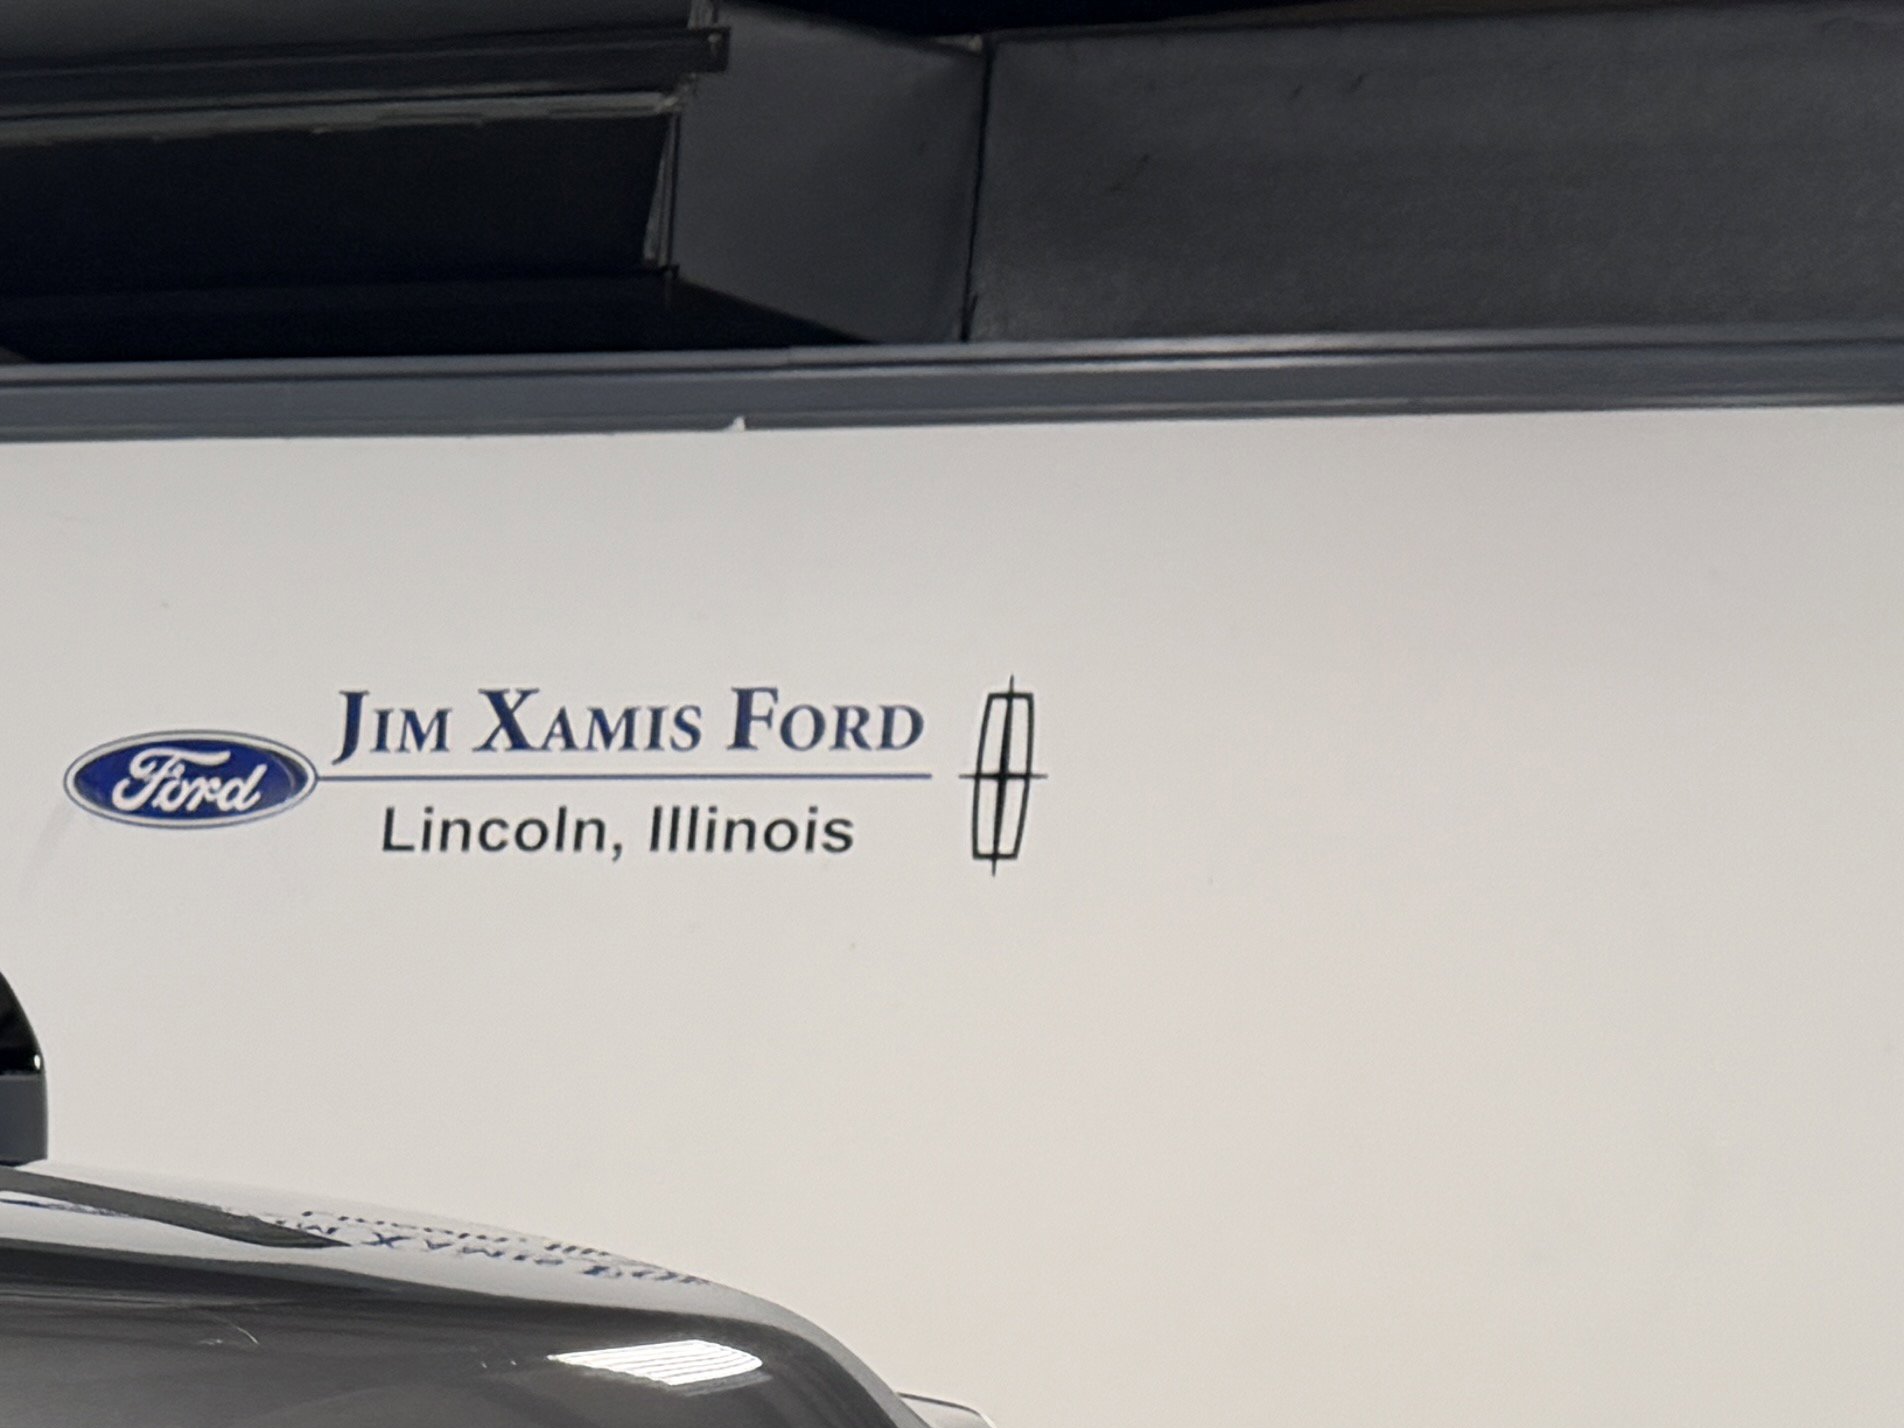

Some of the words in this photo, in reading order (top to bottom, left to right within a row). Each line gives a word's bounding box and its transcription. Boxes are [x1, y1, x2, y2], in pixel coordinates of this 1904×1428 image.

[332, 690, 452, 763] JIM
[471, 688, 702, 752] XAMIS
[728, 688, 927, 751] FORD
[111, 748, 262, 814] Ford
[381, 806, 624, 862] Lincoln,
[648, 806, 853, 853] Illinois
